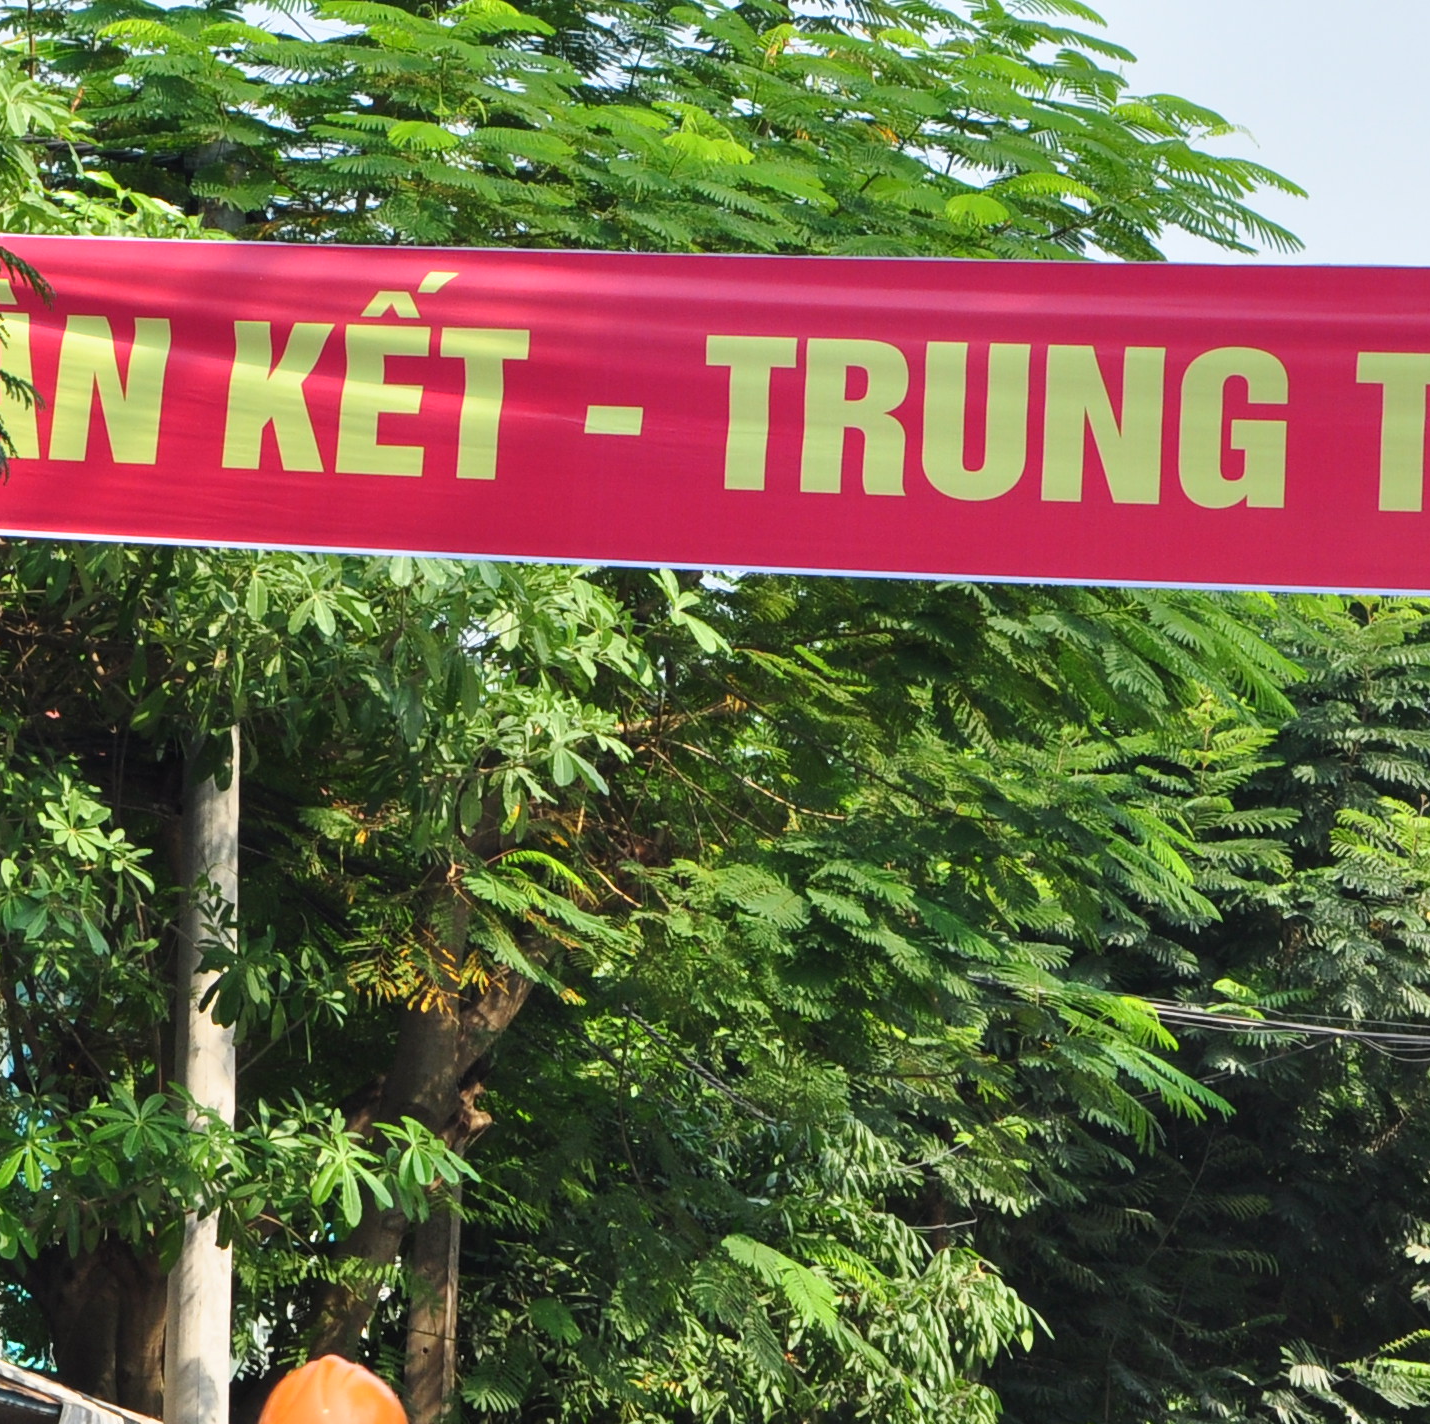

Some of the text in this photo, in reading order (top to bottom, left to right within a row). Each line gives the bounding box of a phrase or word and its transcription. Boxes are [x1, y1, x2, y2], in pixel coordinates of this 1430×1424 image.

[222, 271, 530, 480] KẾT
[584, 405, 644, 436] -
[705, 334, 1289, 509] TRUNG
